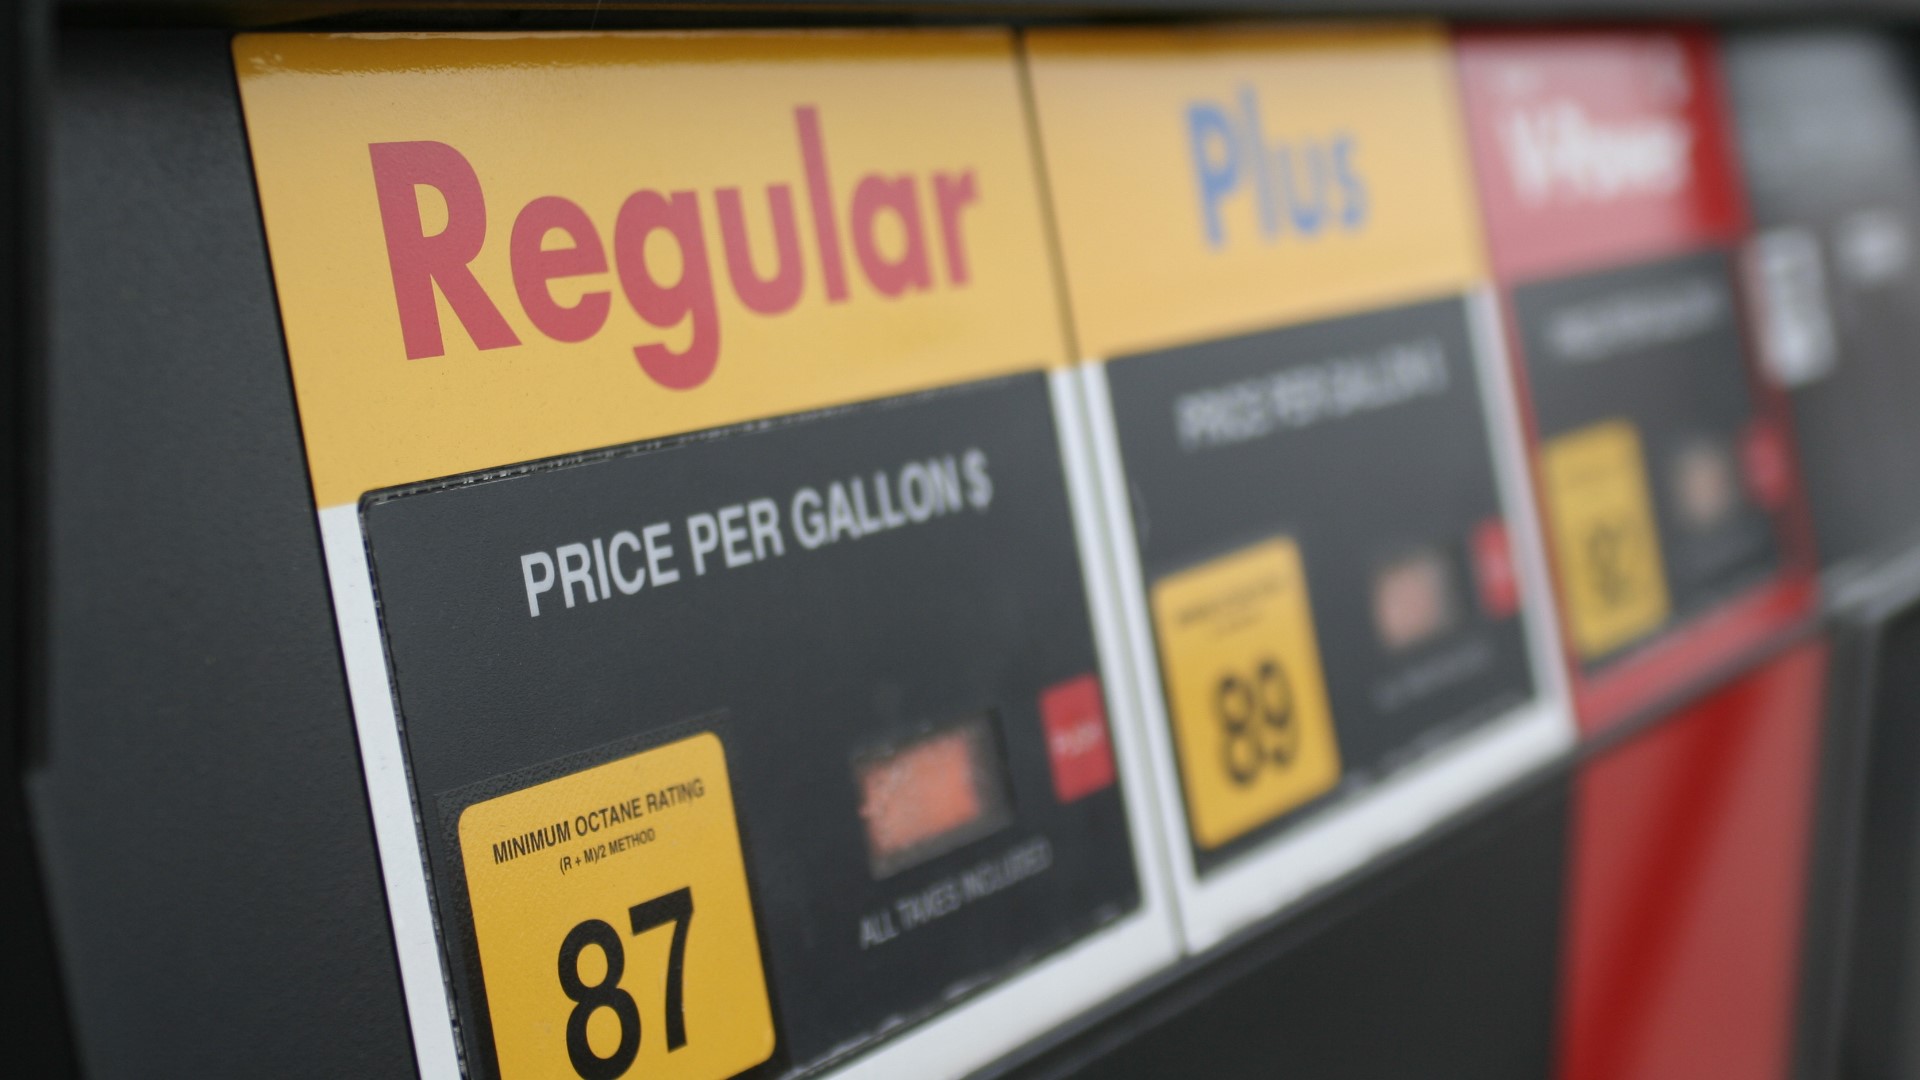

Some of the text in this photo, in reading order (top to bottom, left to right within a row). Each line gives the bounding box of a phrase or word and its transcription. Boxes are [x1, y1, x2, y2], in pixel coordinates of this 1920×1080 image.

[1185, 84, 1370, 248] Plus
[367, 105, 979, 392] Regular
[520, 448, 994, 618] PRICE PER GALLON $
[1211, 653, 1297, 791] 89
[492, 778, 705, 865] MINIMUM OCTANE RATING
[609, 828, 656, 856] METHOD
[558, 886, 694, 1080] 87
[859, 908, 898, 948] ALL
[895, 880, 961, 930] TAXES
